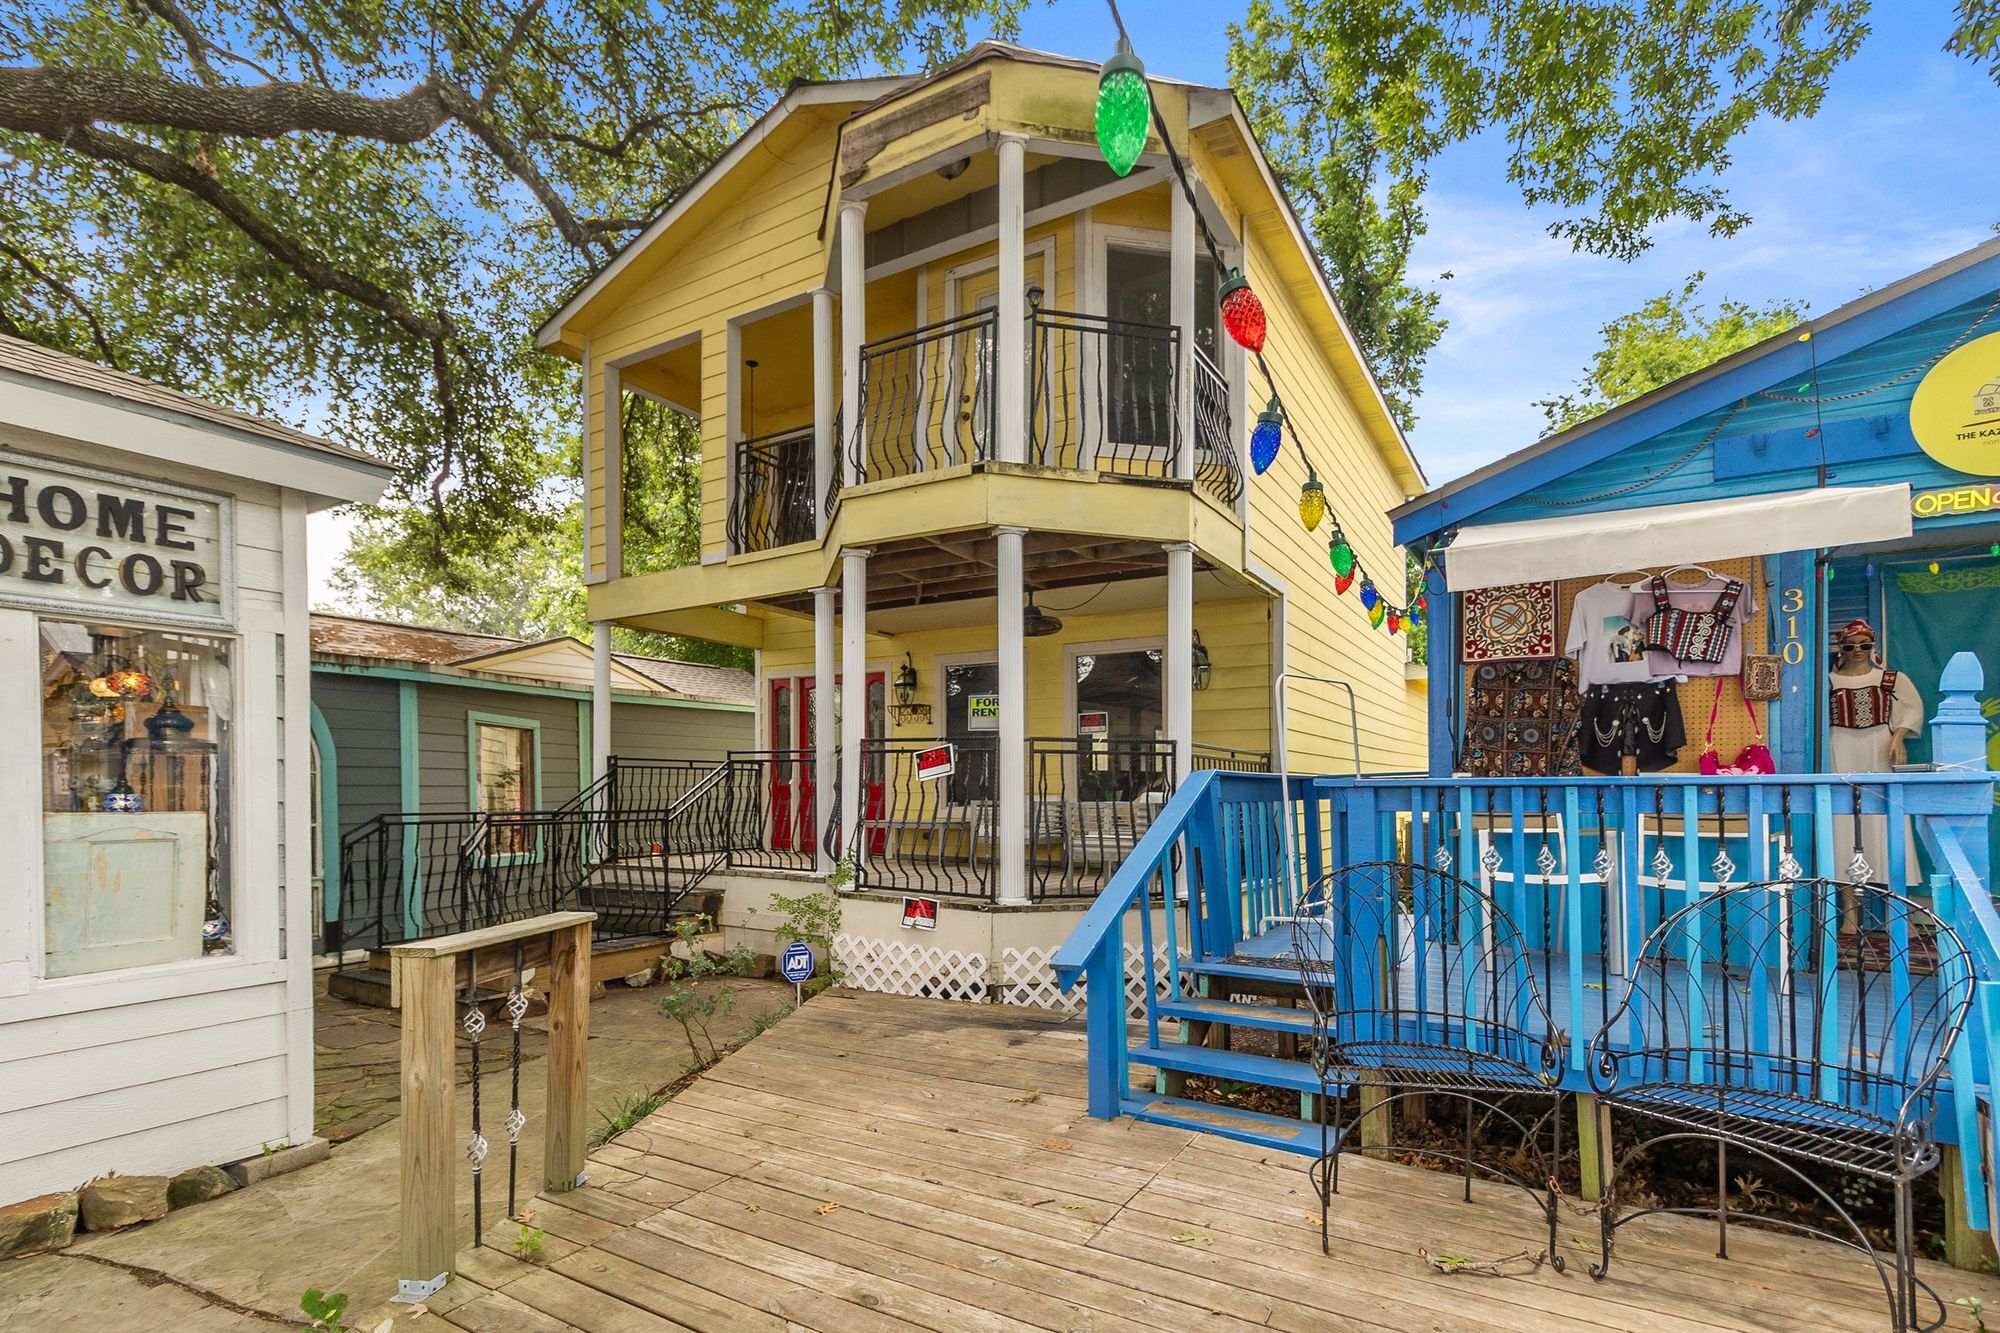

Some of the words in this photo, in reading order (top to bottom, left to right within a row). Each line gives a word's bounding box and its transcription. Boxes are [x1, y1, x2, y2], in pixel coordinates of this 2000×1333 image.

[1956, 431, 1976, 441] THE
[1915, 487, 1991, 513] OPEN
[0, 476, 195, 551] HOME
[1782, 588, 1804, 665] 310
[976, 698, 999, 707] FOR
[919, 755, 948, 769] RENT
[786, 954, 809, 971] ADT
